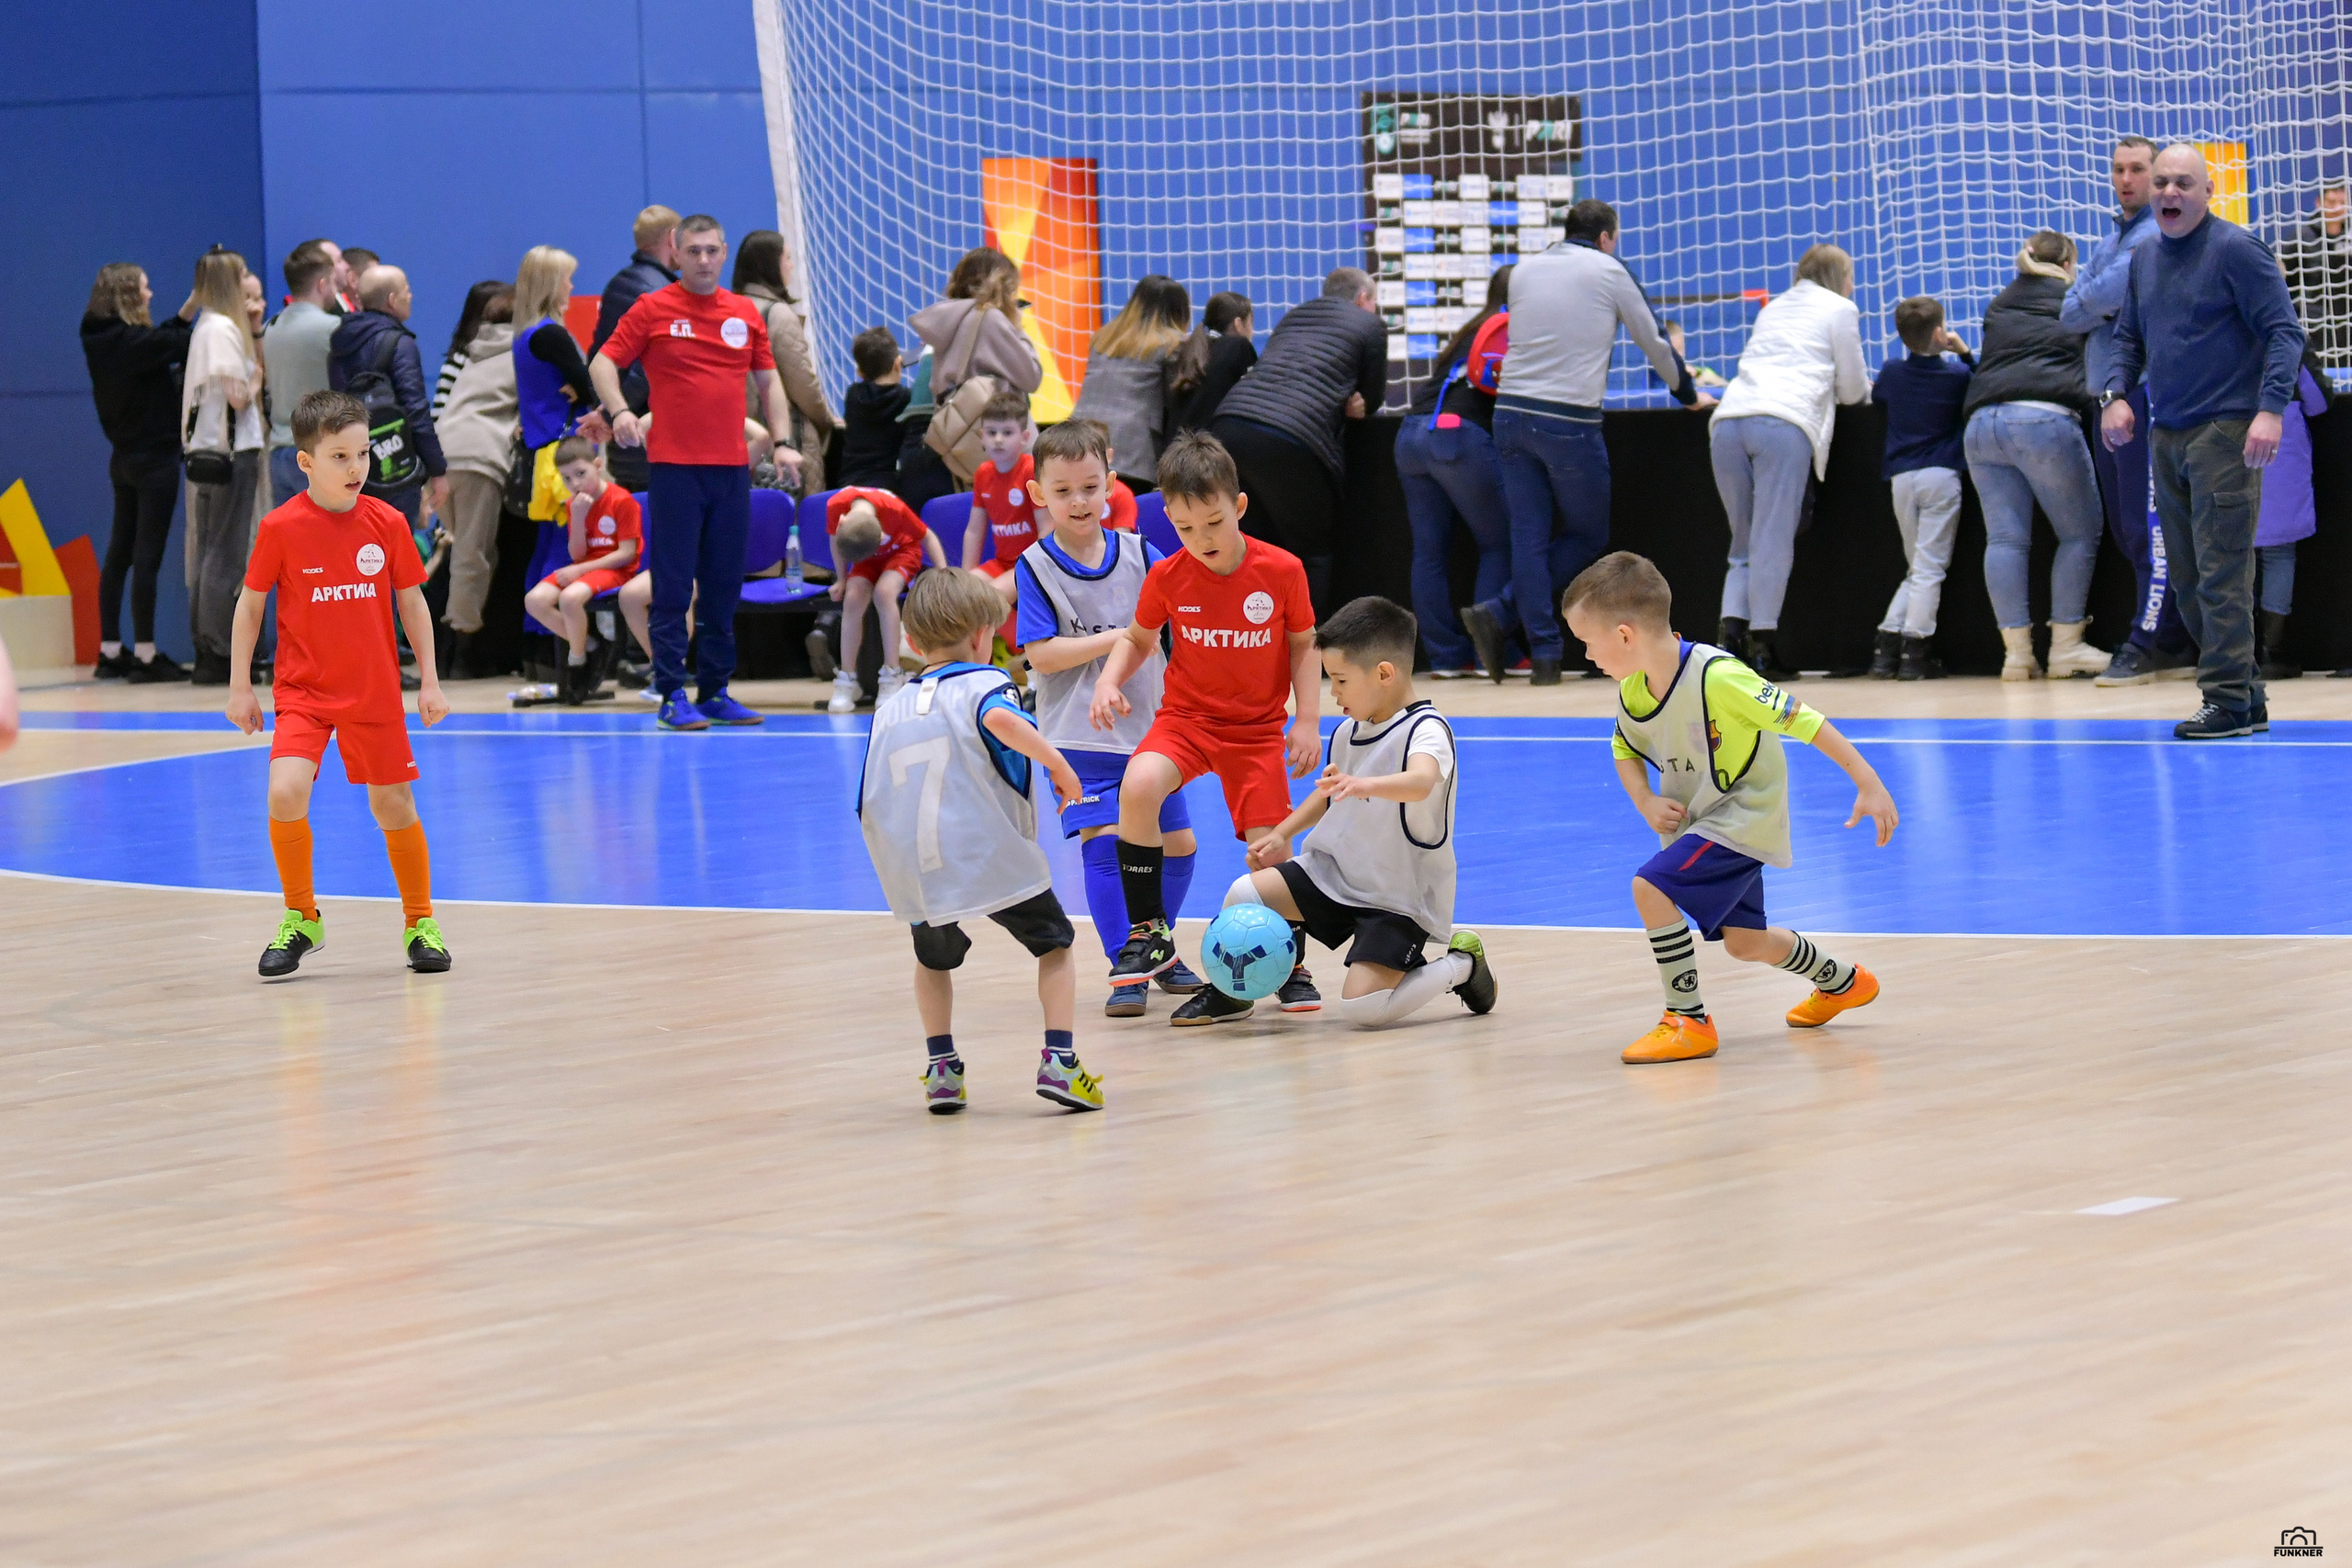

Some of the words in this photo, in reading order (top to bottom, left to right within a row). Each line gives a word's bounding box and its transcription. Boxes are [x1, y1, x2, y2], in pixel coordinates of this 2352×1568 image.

[2151, 525, 2167, 580] URBAN
[2141, 583, 2166, 632] LIONS
[1181, 626, 1272, 649] АРКТИКА
[888, 736, 951, 873] 7
[1122, 863, 1153, 874] TORRES
